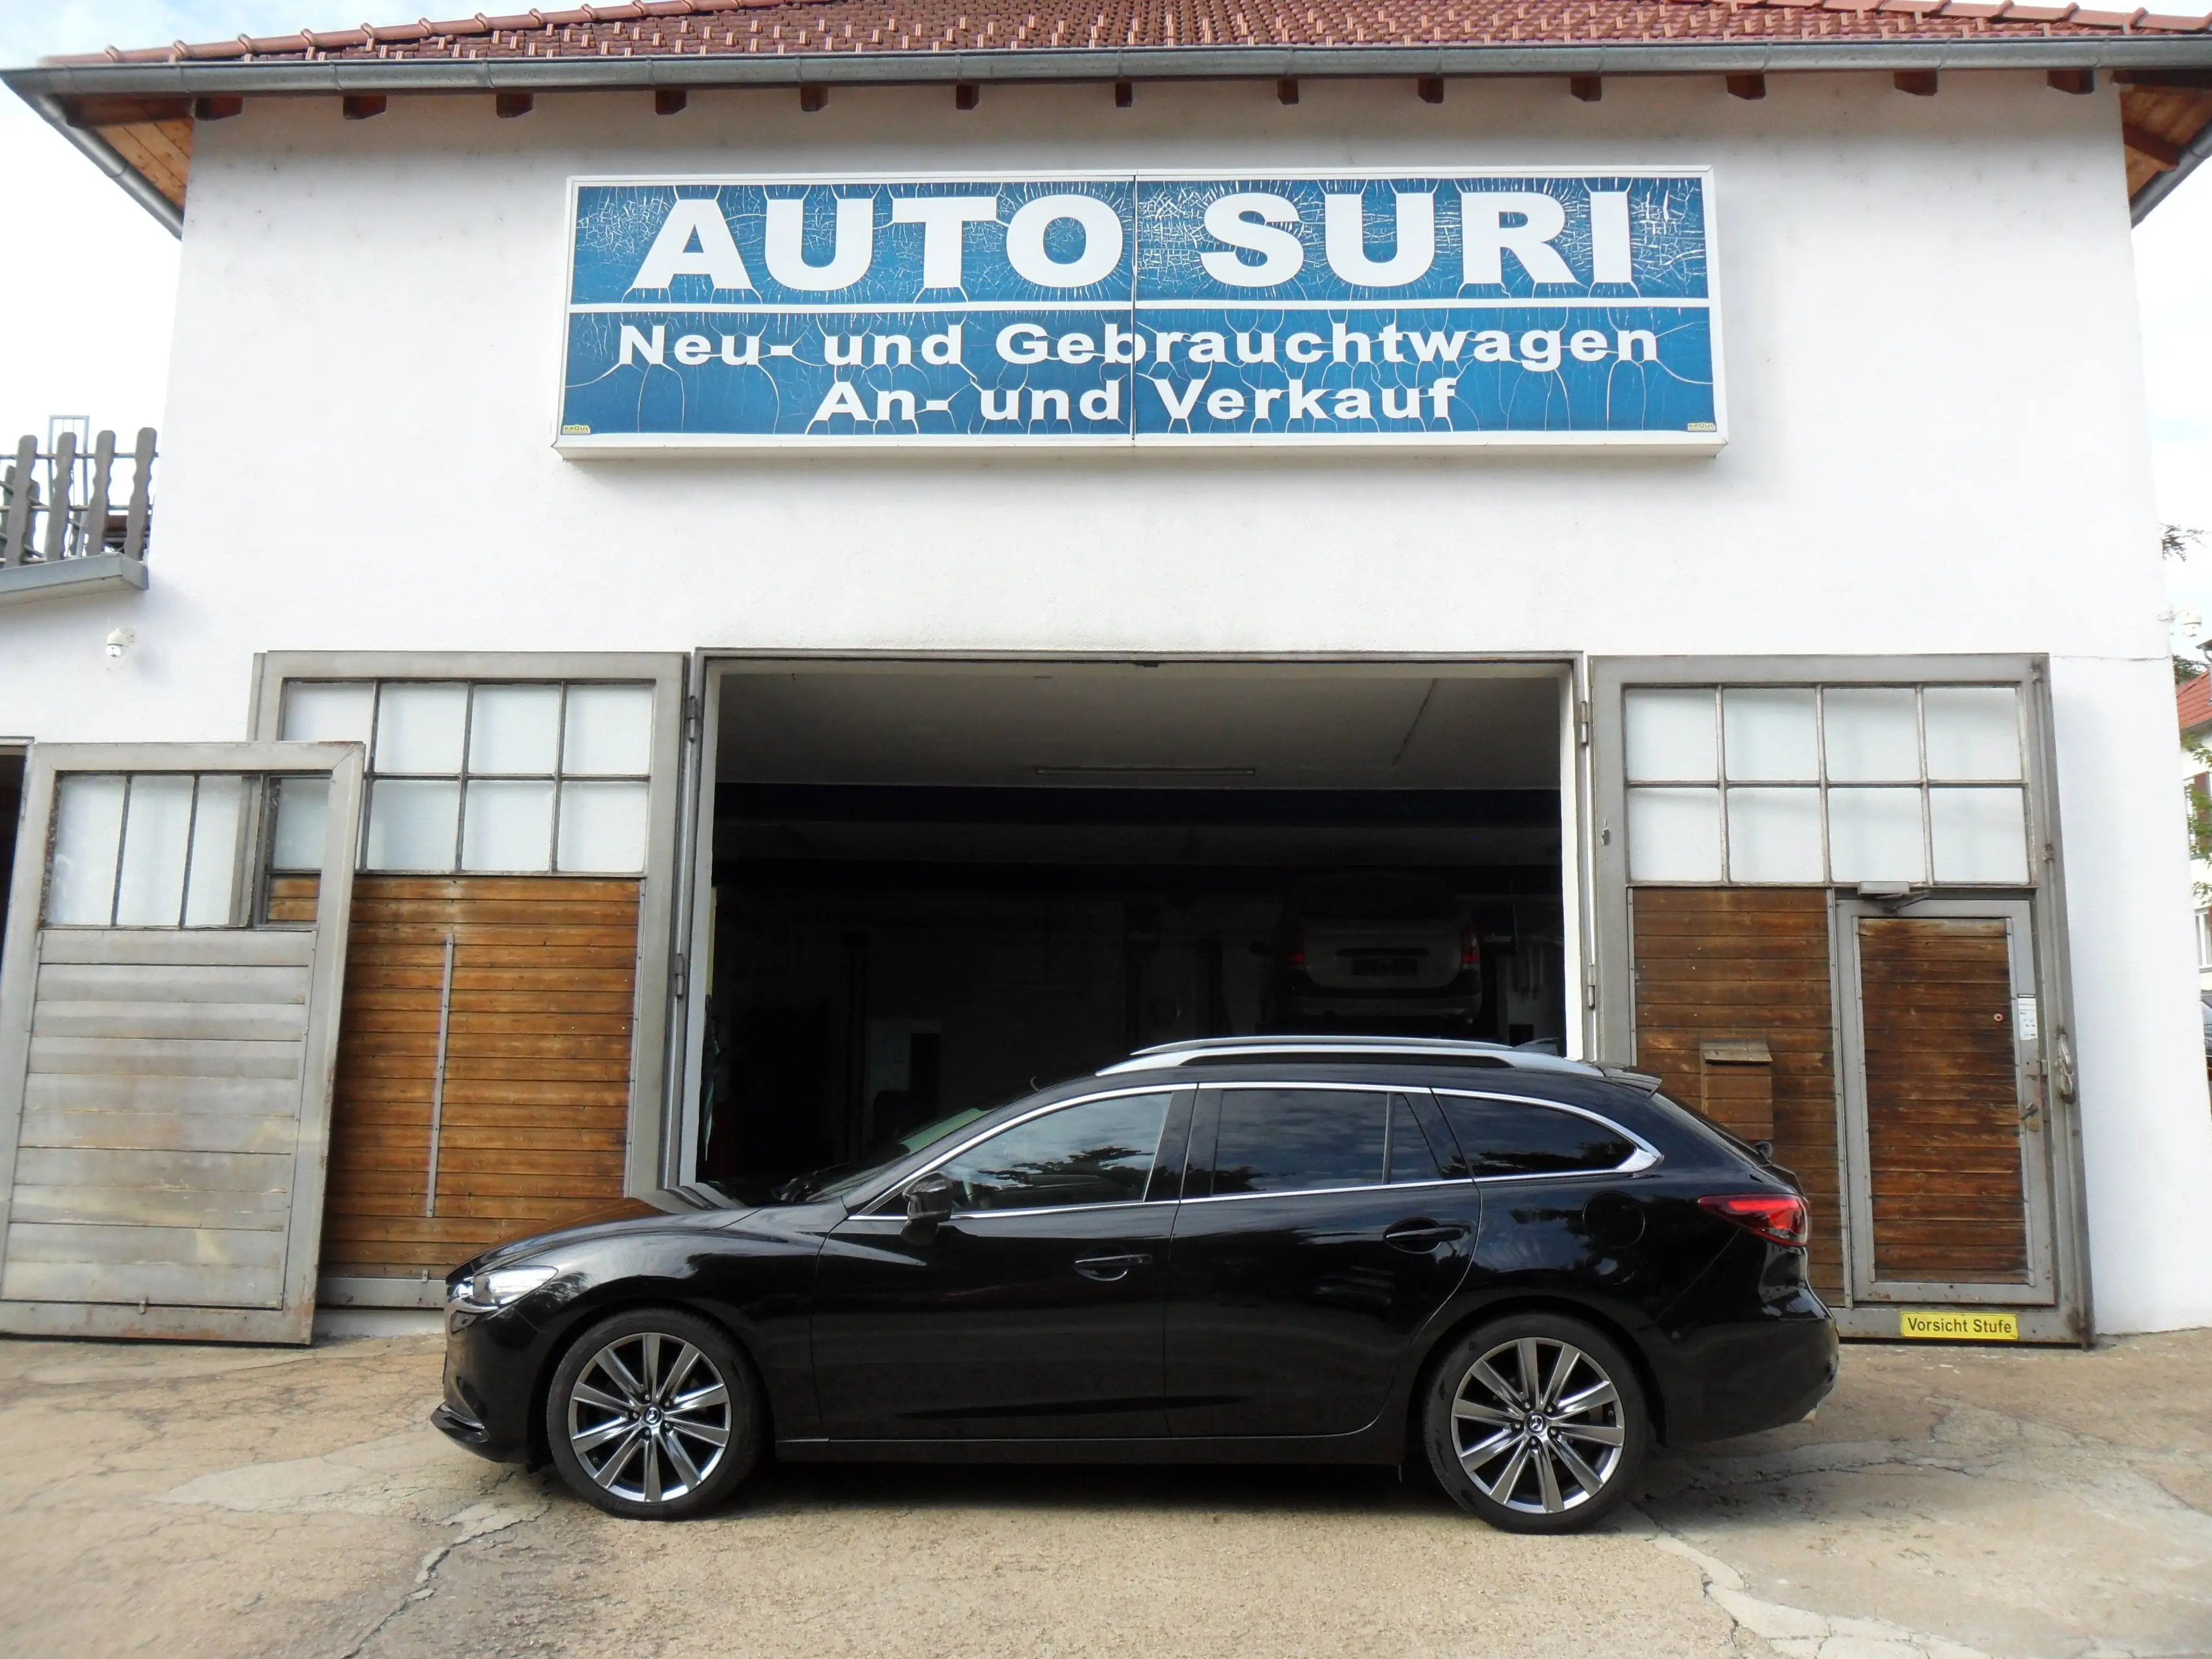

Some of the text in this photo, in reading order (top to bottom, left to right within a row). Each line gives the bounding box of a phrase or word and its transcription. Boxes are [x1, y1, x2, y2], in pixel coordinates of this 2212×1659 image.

[631, 191, 1633, 291] AUTO SURI
[619, 321, 1657, 372] Neu- und Gebrauchtwagen
[814, 377, 1456, 421] An- und Verkauf
[1908, 1317, 2012, 1333] Vorsicht Stufe
